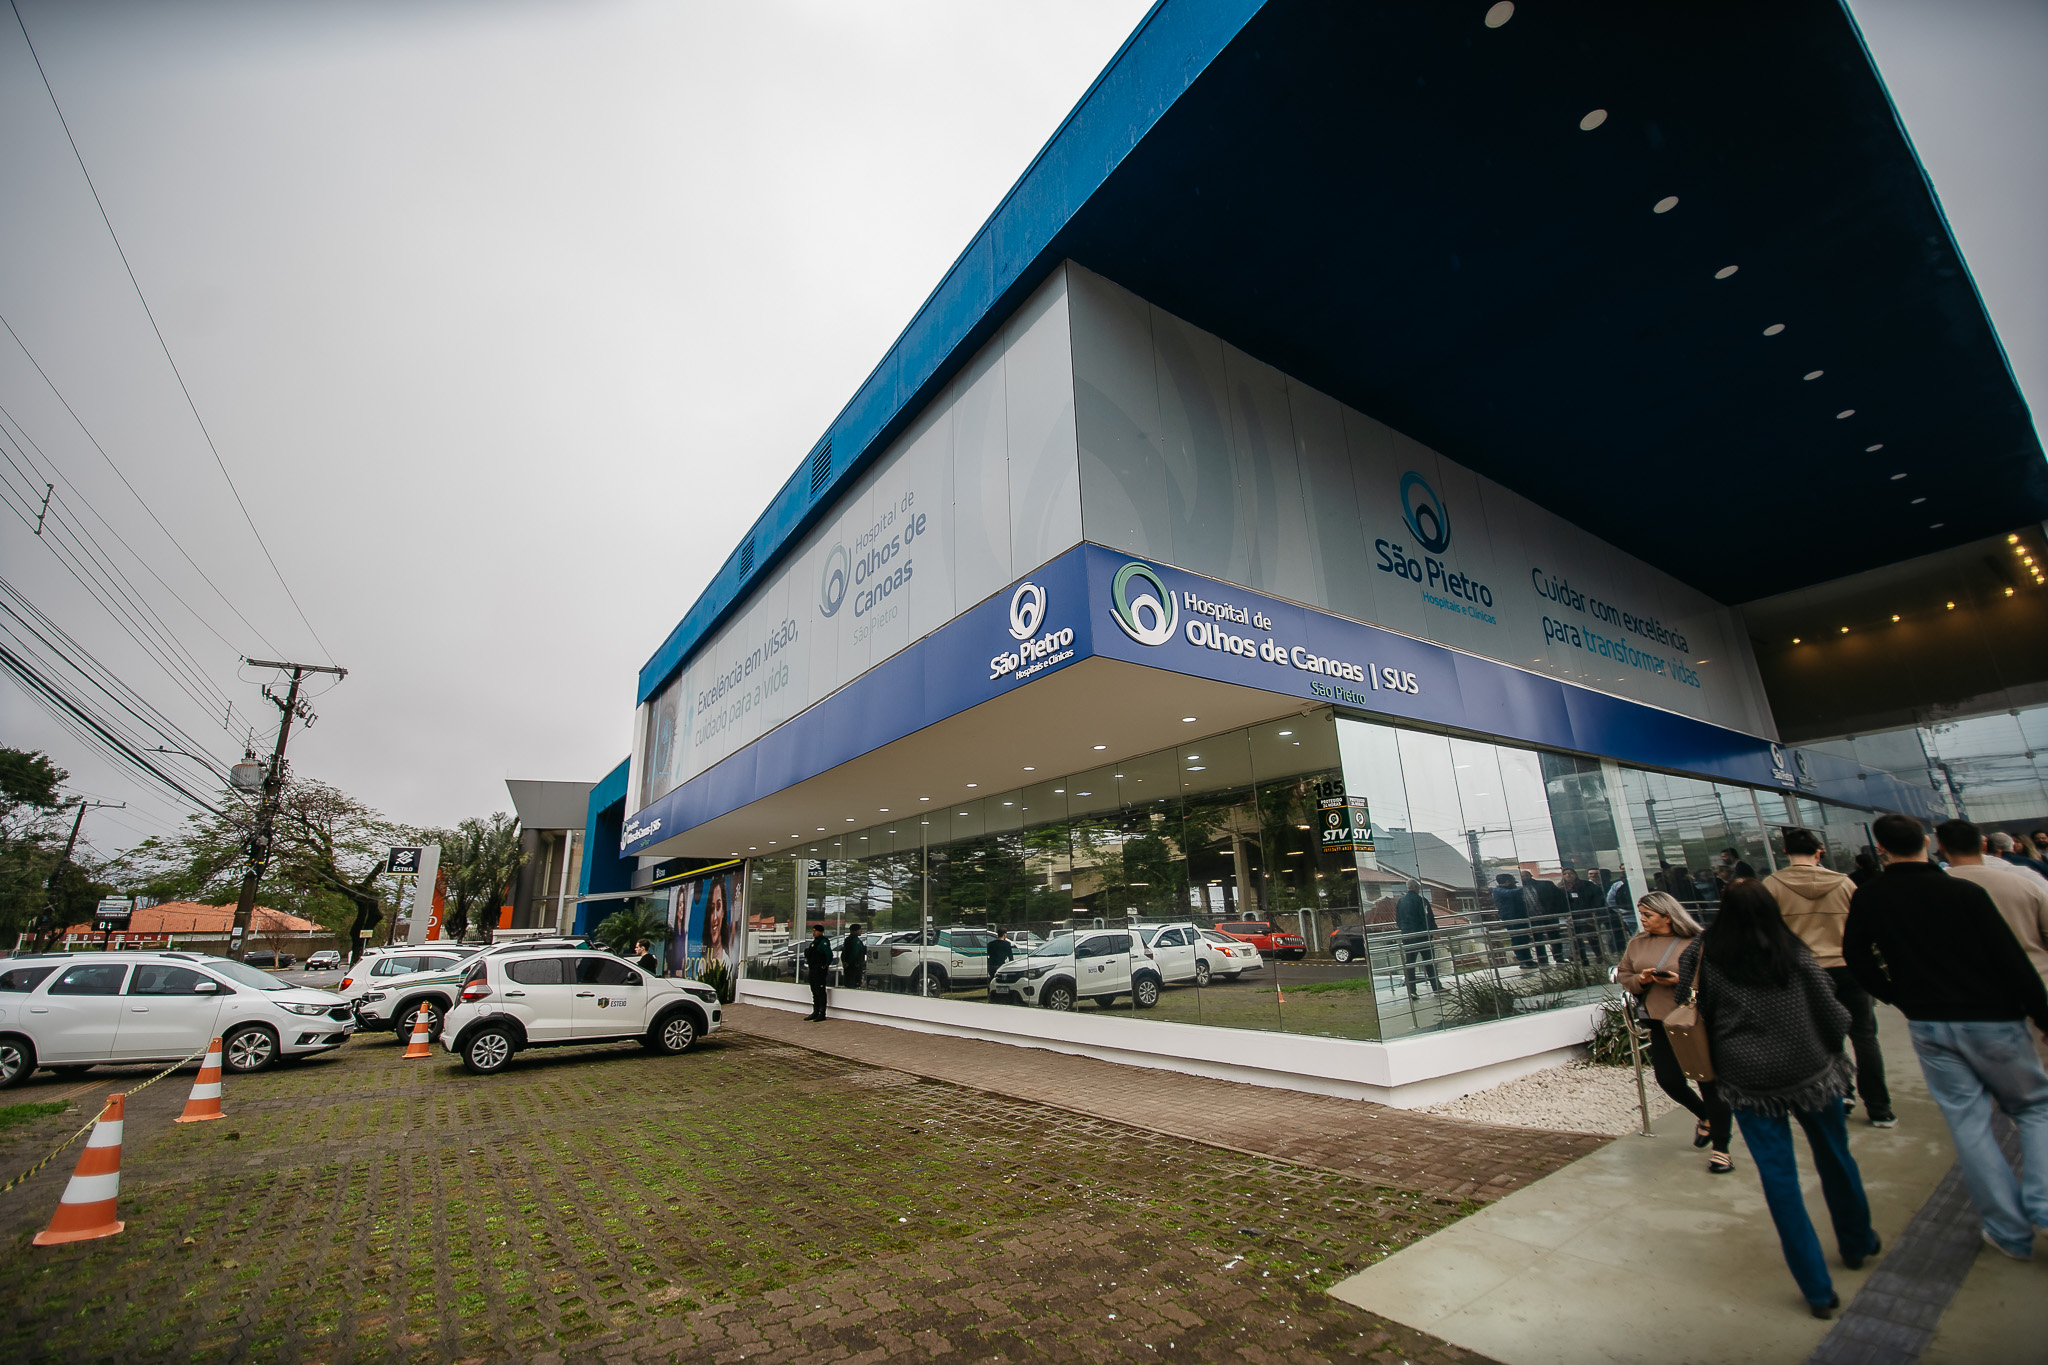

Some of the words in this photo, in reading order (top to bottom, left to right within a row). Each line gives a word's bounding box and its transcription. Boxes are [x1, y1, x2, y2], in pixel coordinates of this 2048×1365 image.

[855, 534, 900, 586] Olhos
[904, 513, 926, 545] de
[856, 502, 897, 554] Hospital
[901, 491, 914, 513] de
[854, 558, 913, 618] Canoas
[1375, 538, 1422, 583] São
[1424, 556, 1493, 608] Pietro
[853, 624, 869, 646] São
[871, 605, 898, 631] Pietro
[1183, 592, 1249, 625] Hospital
[1252, 612, 1272, 631] de
[1422, 590, 1461, 614] Hospitais
[1462, 606, 1468, 616] e
[1468, 605, 1497, 625] Clínicas
[1532, 567, 1586, 613] Cuidar
[1590, 598, 1622, 628] com
[1623, 612, 1690, 654] excelência
[697, 660, 742, 716] Excelência
[744, 648, 760, 678] em
[764, 618, 799, 662] visão,
[990, 651, 1020, 680] São
[1020, 628, 1074, 666] Pietro
[1015, 662, 1044, 680] Hospitais
[1044, 660, 1048, 668] e
[1048, 649, 1074, 666] Clínicas
[1185, 620, 1257, 658] Olhos
[1259, 638, 1288, 665] de
[1290, 646, 1365, 682] Canoas
[1382, 667, 1419, 694] SUS
[1542, 616, 1582, 646] para
[1582, 625, 1667, 678] transformar
[1667, 657, 1701, 689] vidas
[695, 704, 728, 748] cuidado
[728, 690, 752, 732] para
[753, 684, 760, 707] a
[764, 660, 789, 700] vida
[1310, 680, 1332, 698] São
[1334, 685, 1366, 704] Pietro
[1313, 780, 1344, 798] 185
[1322, 828, 1350, 842] STV
[1352, 828, 1372, 840] STV
